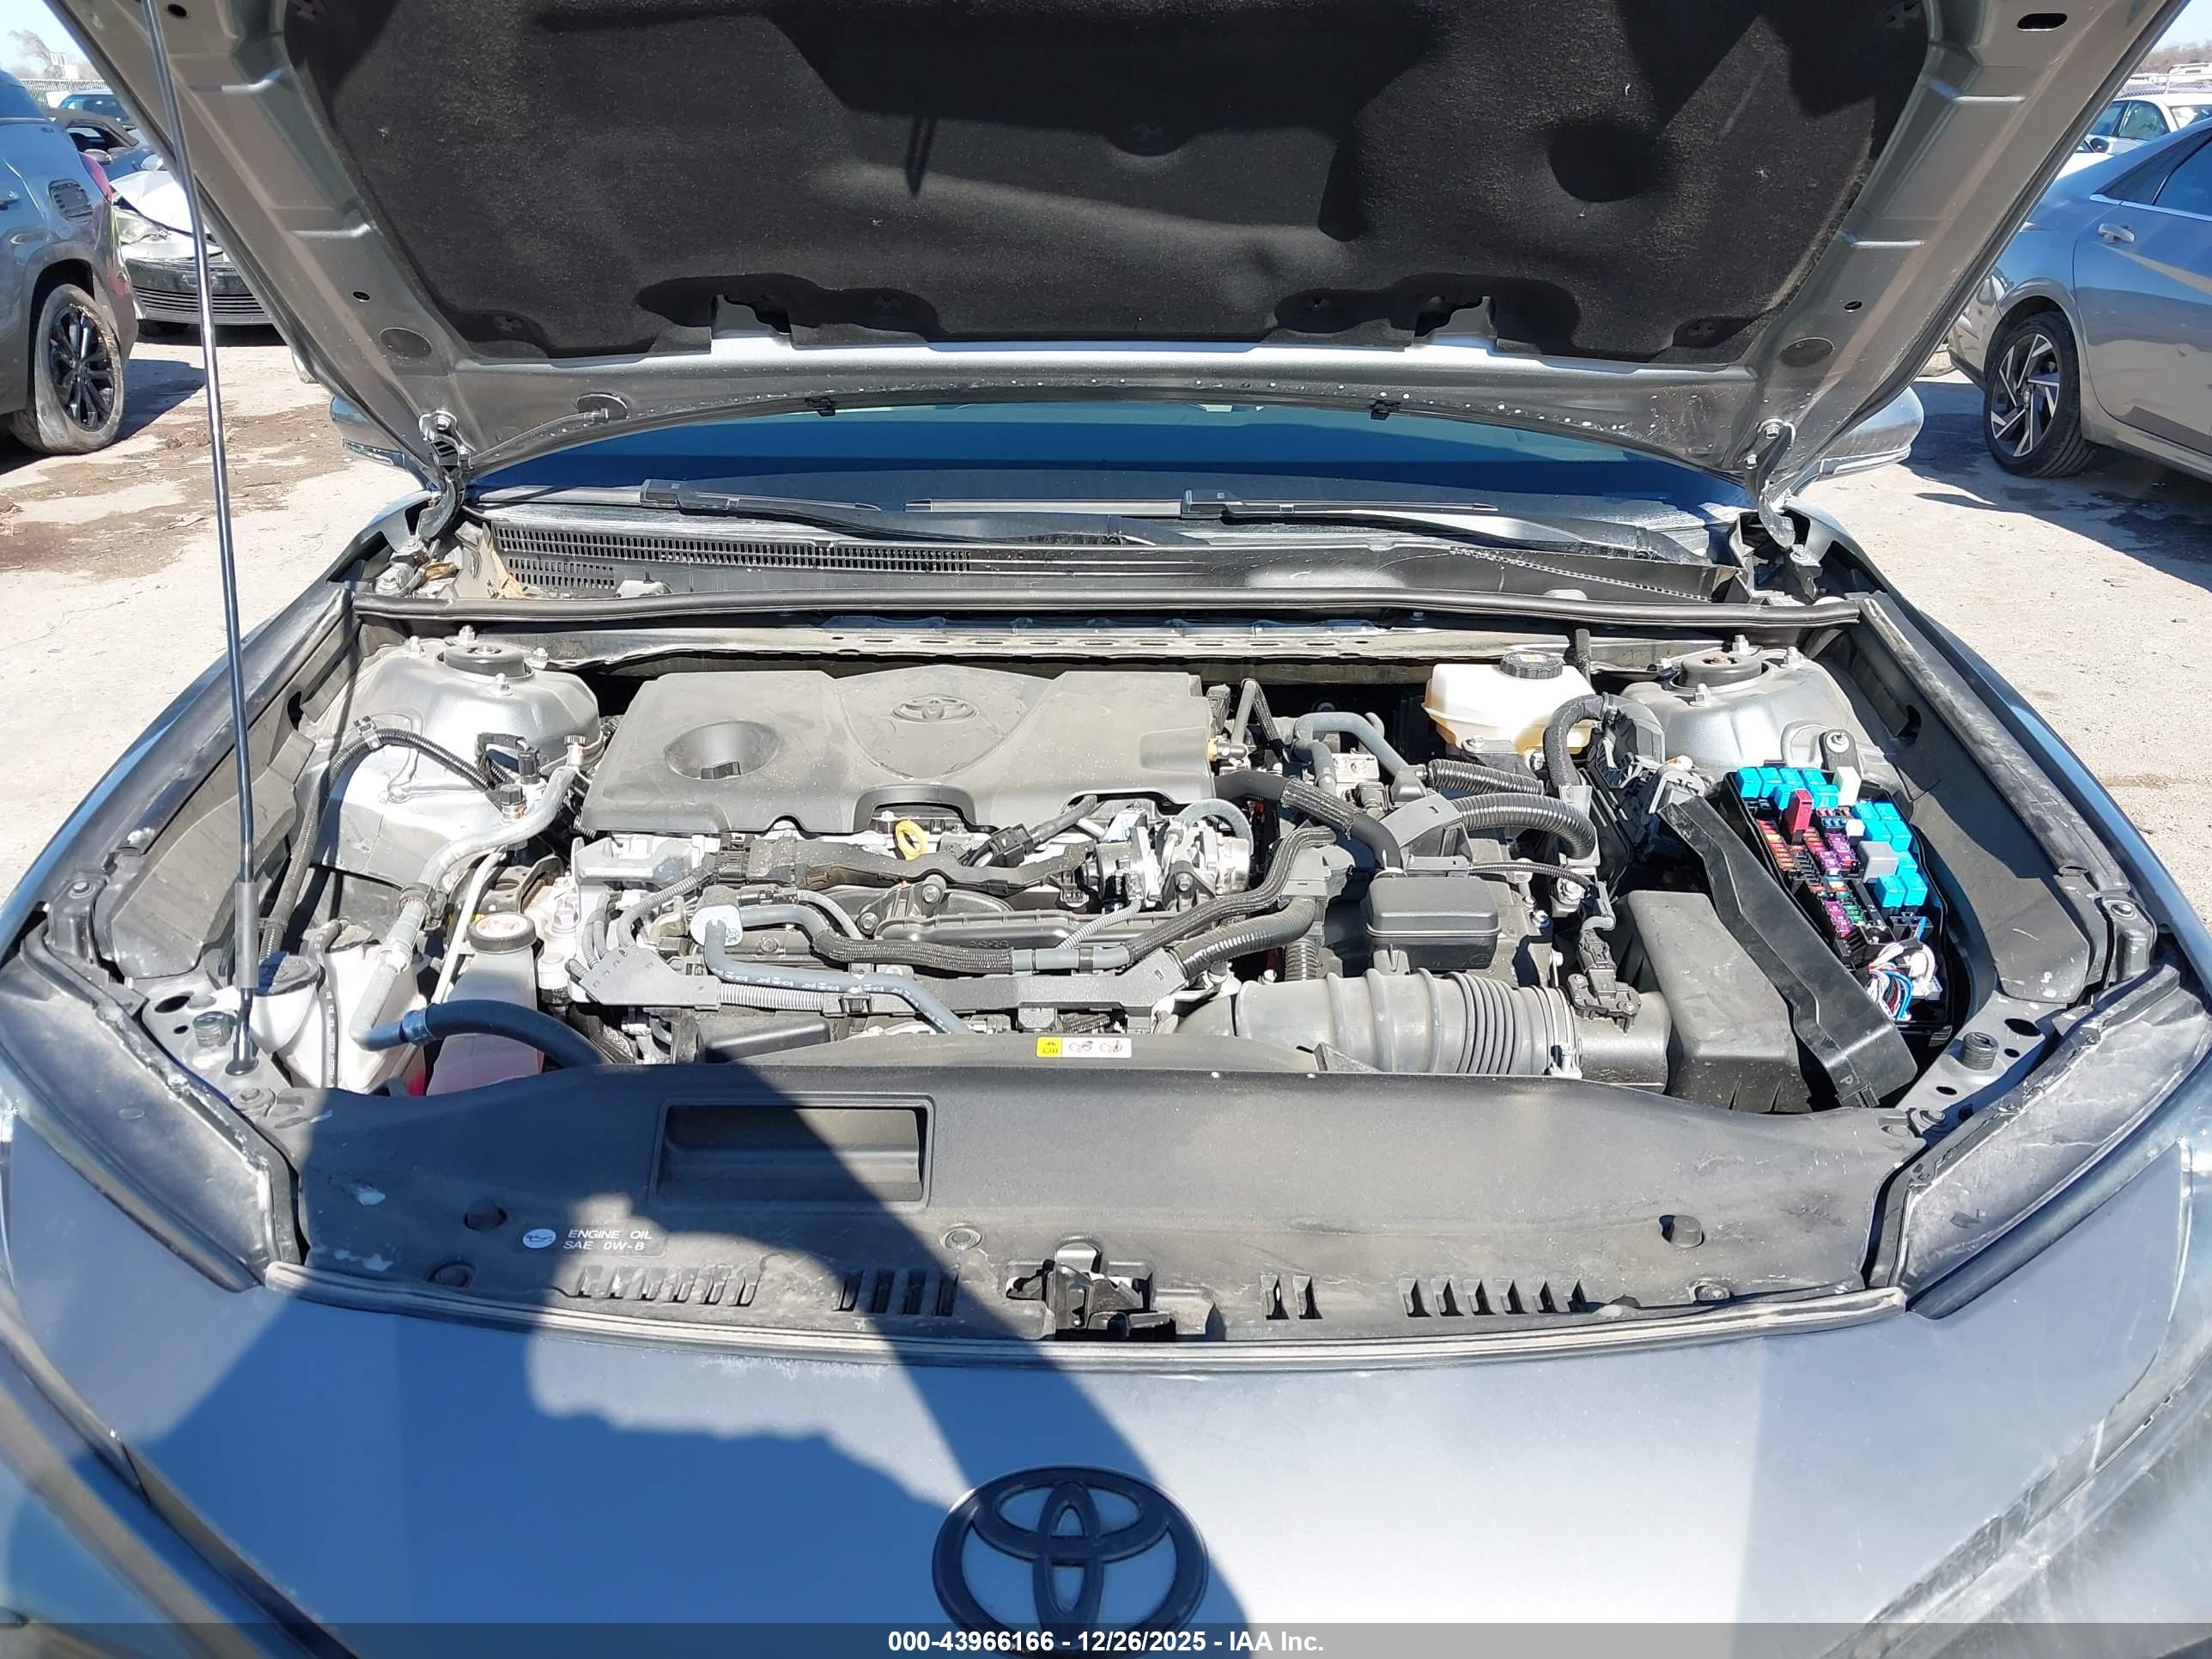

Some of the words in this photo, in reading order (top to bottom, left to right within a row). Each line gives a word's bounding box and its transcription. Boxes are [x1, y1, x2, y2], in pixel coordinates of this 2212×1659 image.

[568, 1230, 621, 1239] ENGINE
[629, 1230, 653, 1240] OIL
[562, 1240, 593, 1250] SAE
